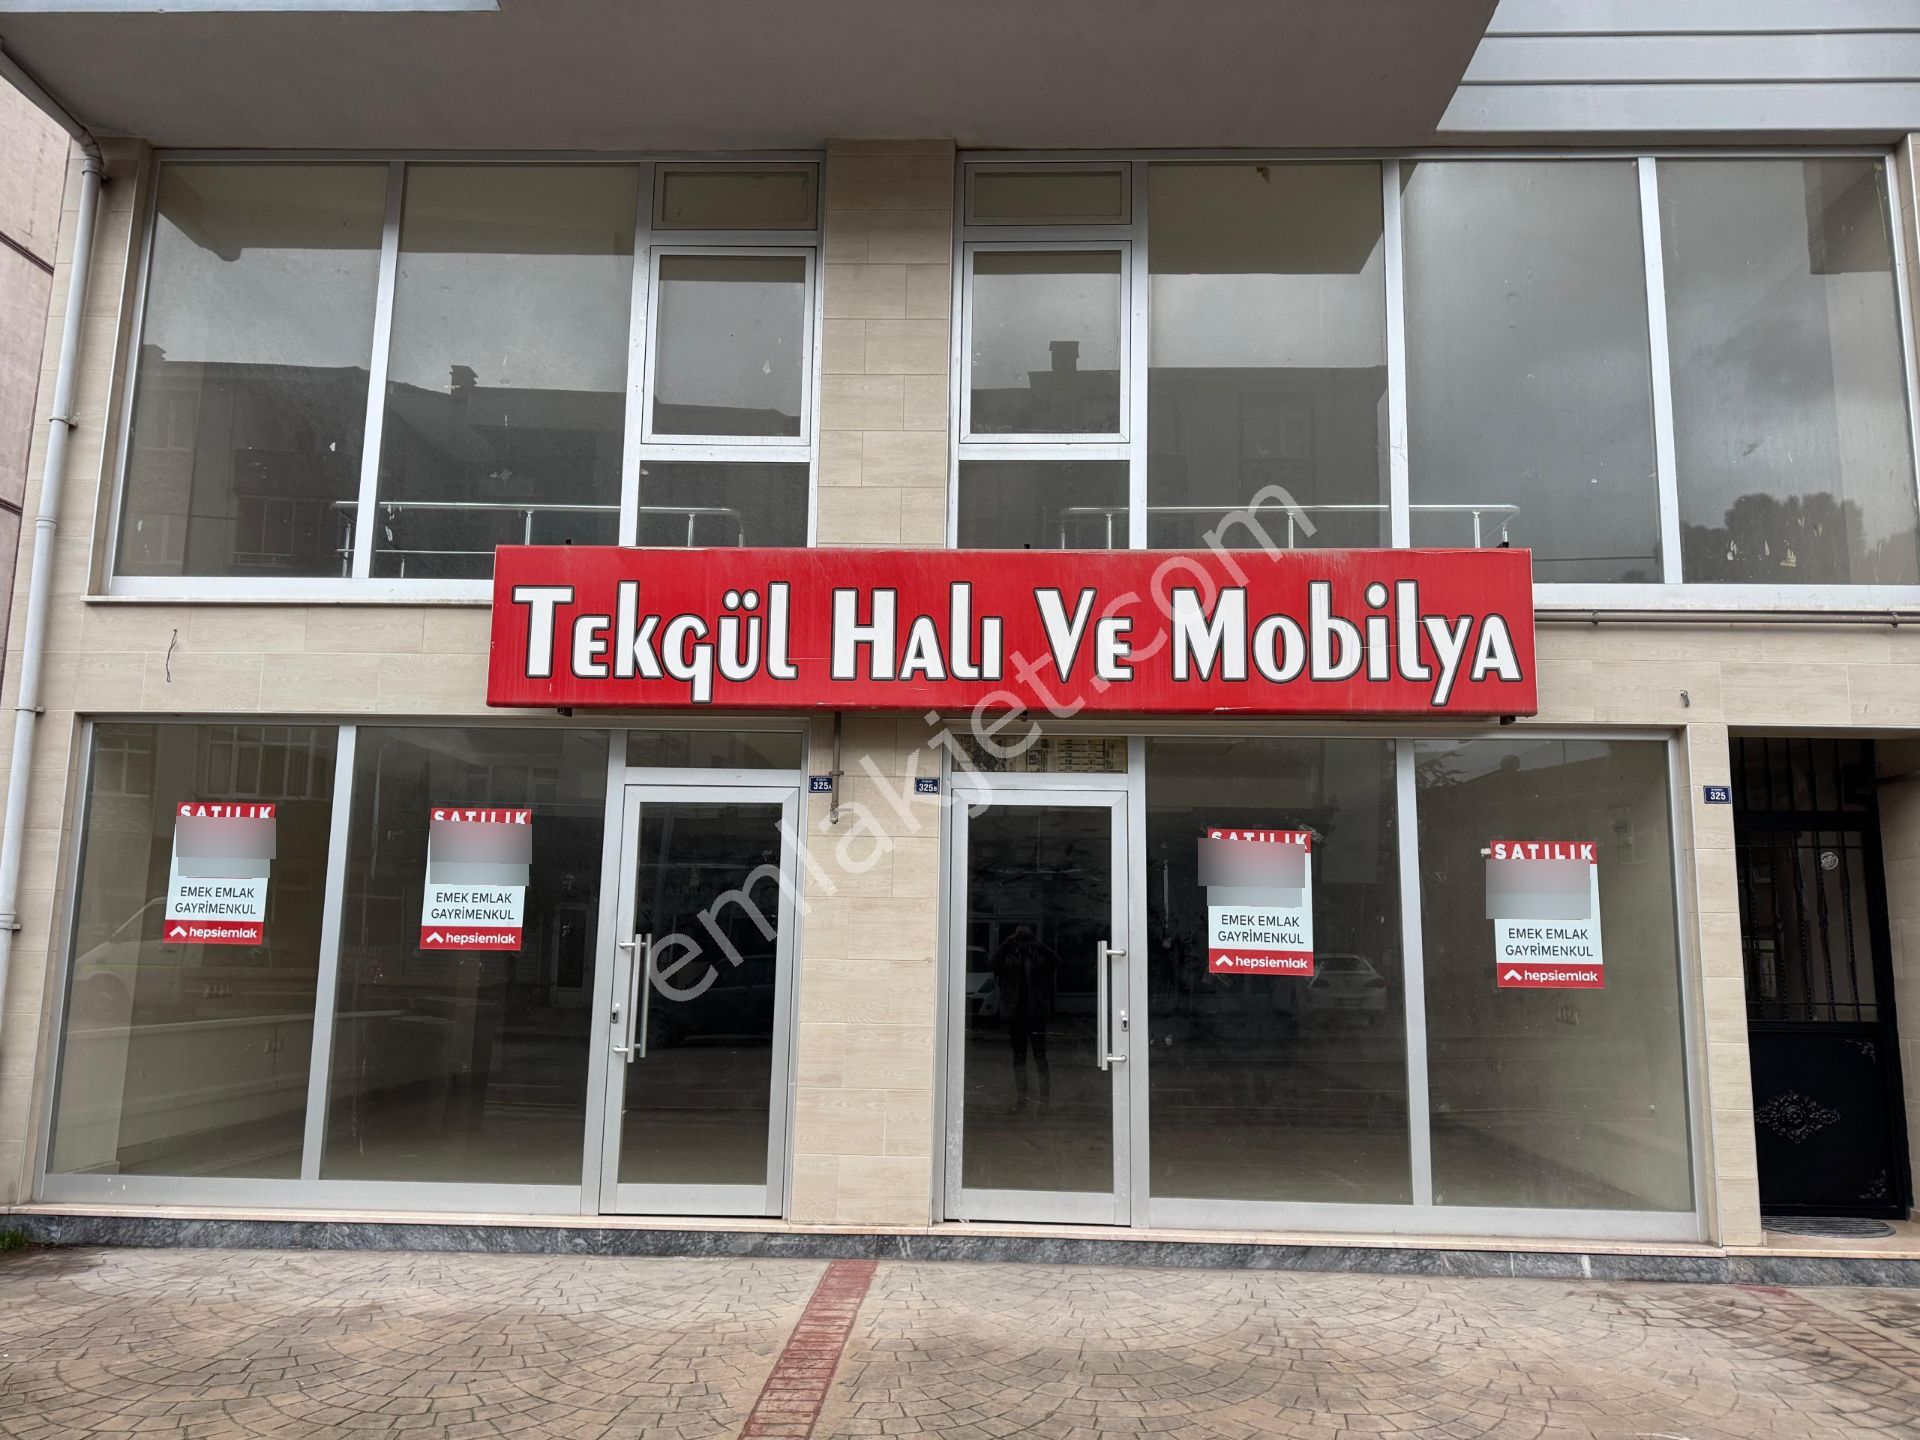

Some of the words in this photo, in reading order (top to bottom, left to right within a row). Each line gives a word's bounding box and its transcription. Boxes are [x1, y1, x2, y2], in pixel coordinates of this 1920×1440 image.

[512, 580, 798, 703] Tekgül
[830, 581, 1003, 681] Halı
[1033, 587, 1133, 682] Ve
[1172, 580, 1522, 706] Mobilya
[1710, 791, 1727, 800] 325
[180, 805, 272, 819] SATILIK
[1494, 843, 1594, 860] SATILIK
[180, 886, 213, 897] EMEK
[215, 887, 255, 898] EMLAK
[436, 892, 469, 904] EMEK
[472, 892, 512, 904] EMLAK
[175, 900, 257, 915] GAYRİMENKUL
[431, 906, 515, 920] GAYRİMENKUL
[1221, 914, 1255, 926] EMEK
[1258, 915, 1300, 927] EMLAK
[189, 926, 258, 939] hepsiemlak
[445, 932, 516, 945] hepsiemlak
[1218, 929, 1304, 944] GAYRİMENKUL
[1508, 928, 1543, 940] EMEK
[1546, 928, 1589, 940] EMLAK
[1505, 943, 1594, 957] GAYRİMENKUL
[1235, 956, 1309, 969] hepsiemlak
[1524, 969, 1599, 983] hepsiemlak
